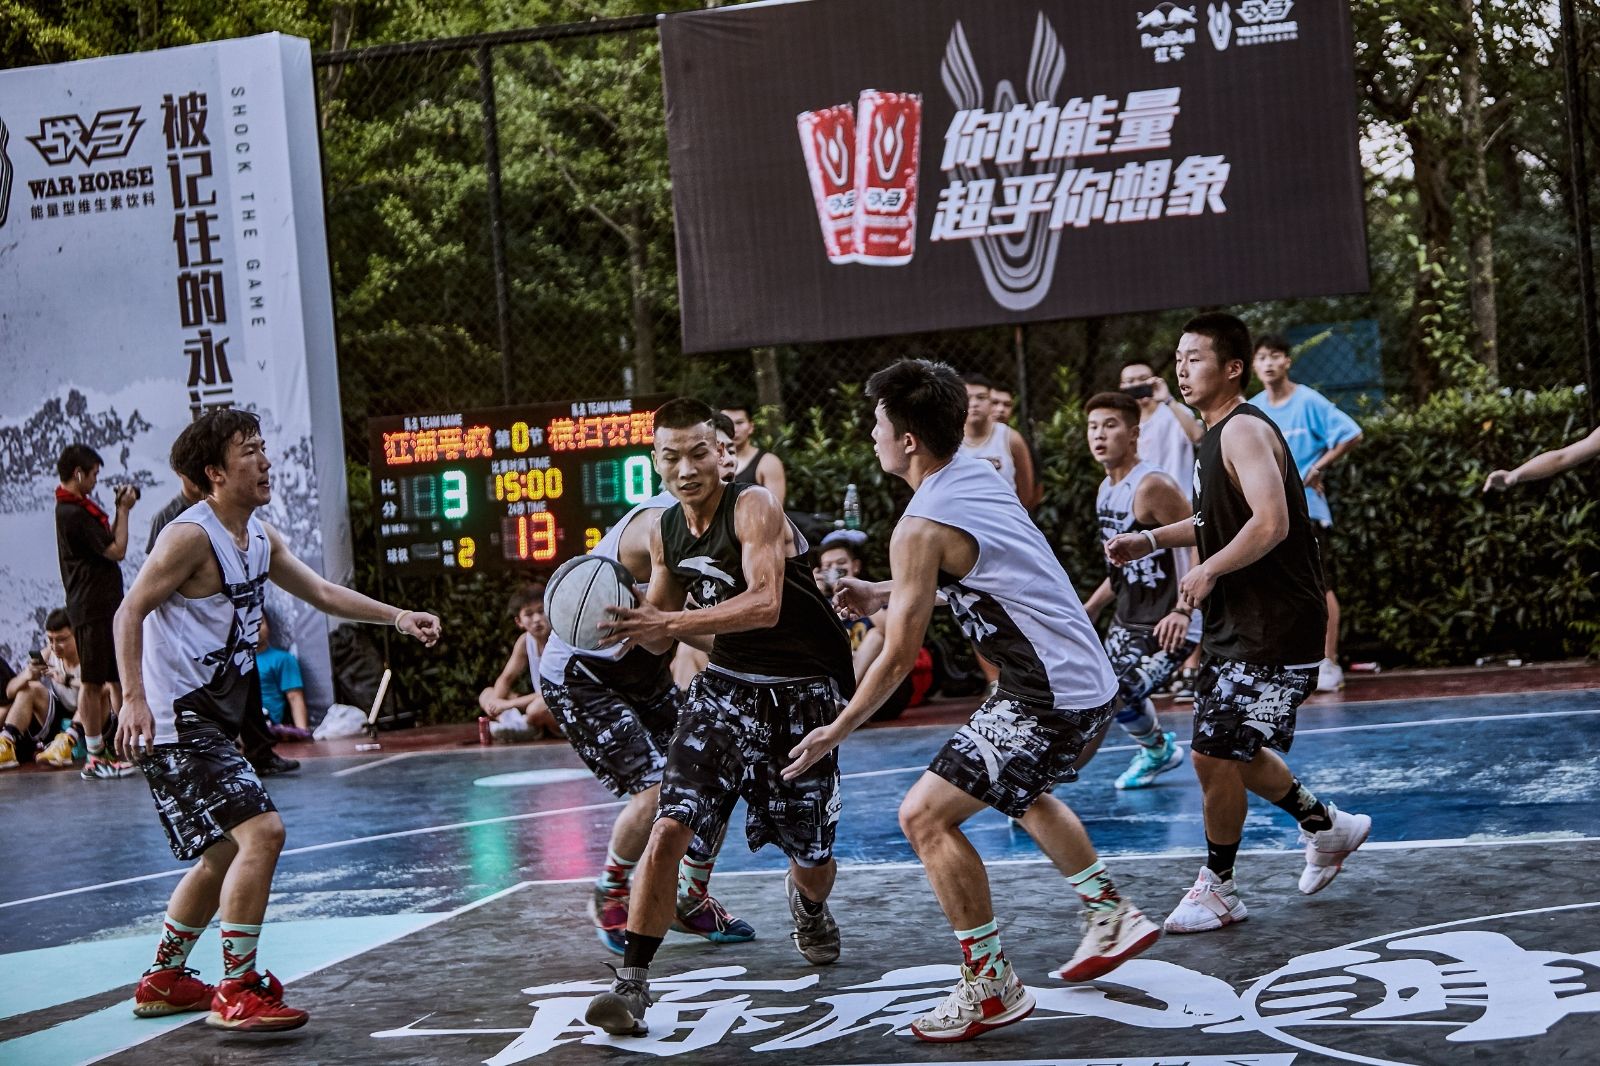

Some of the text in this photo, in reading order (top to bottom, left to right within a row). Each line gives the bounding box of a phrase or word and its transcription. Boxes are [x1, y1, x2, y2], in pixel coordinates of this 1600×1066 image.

[940, 87, 1181, 171] 你的能量
[28, 166, 154, 200] WAR HORSE
[31, 191, 156, 221] 能量型维生素饮料
[231, 86, 266, 327] SHOCK THE GAME
[930, 155, 1231, 242] 超乎你想象
[443, 470, 468, 519] 3
[496, 467, 563, 501] 15:00
[624, 455, 652, 504] 0
[458, 537, 476, 568] 2
[519, 512, 556, 560] 13
